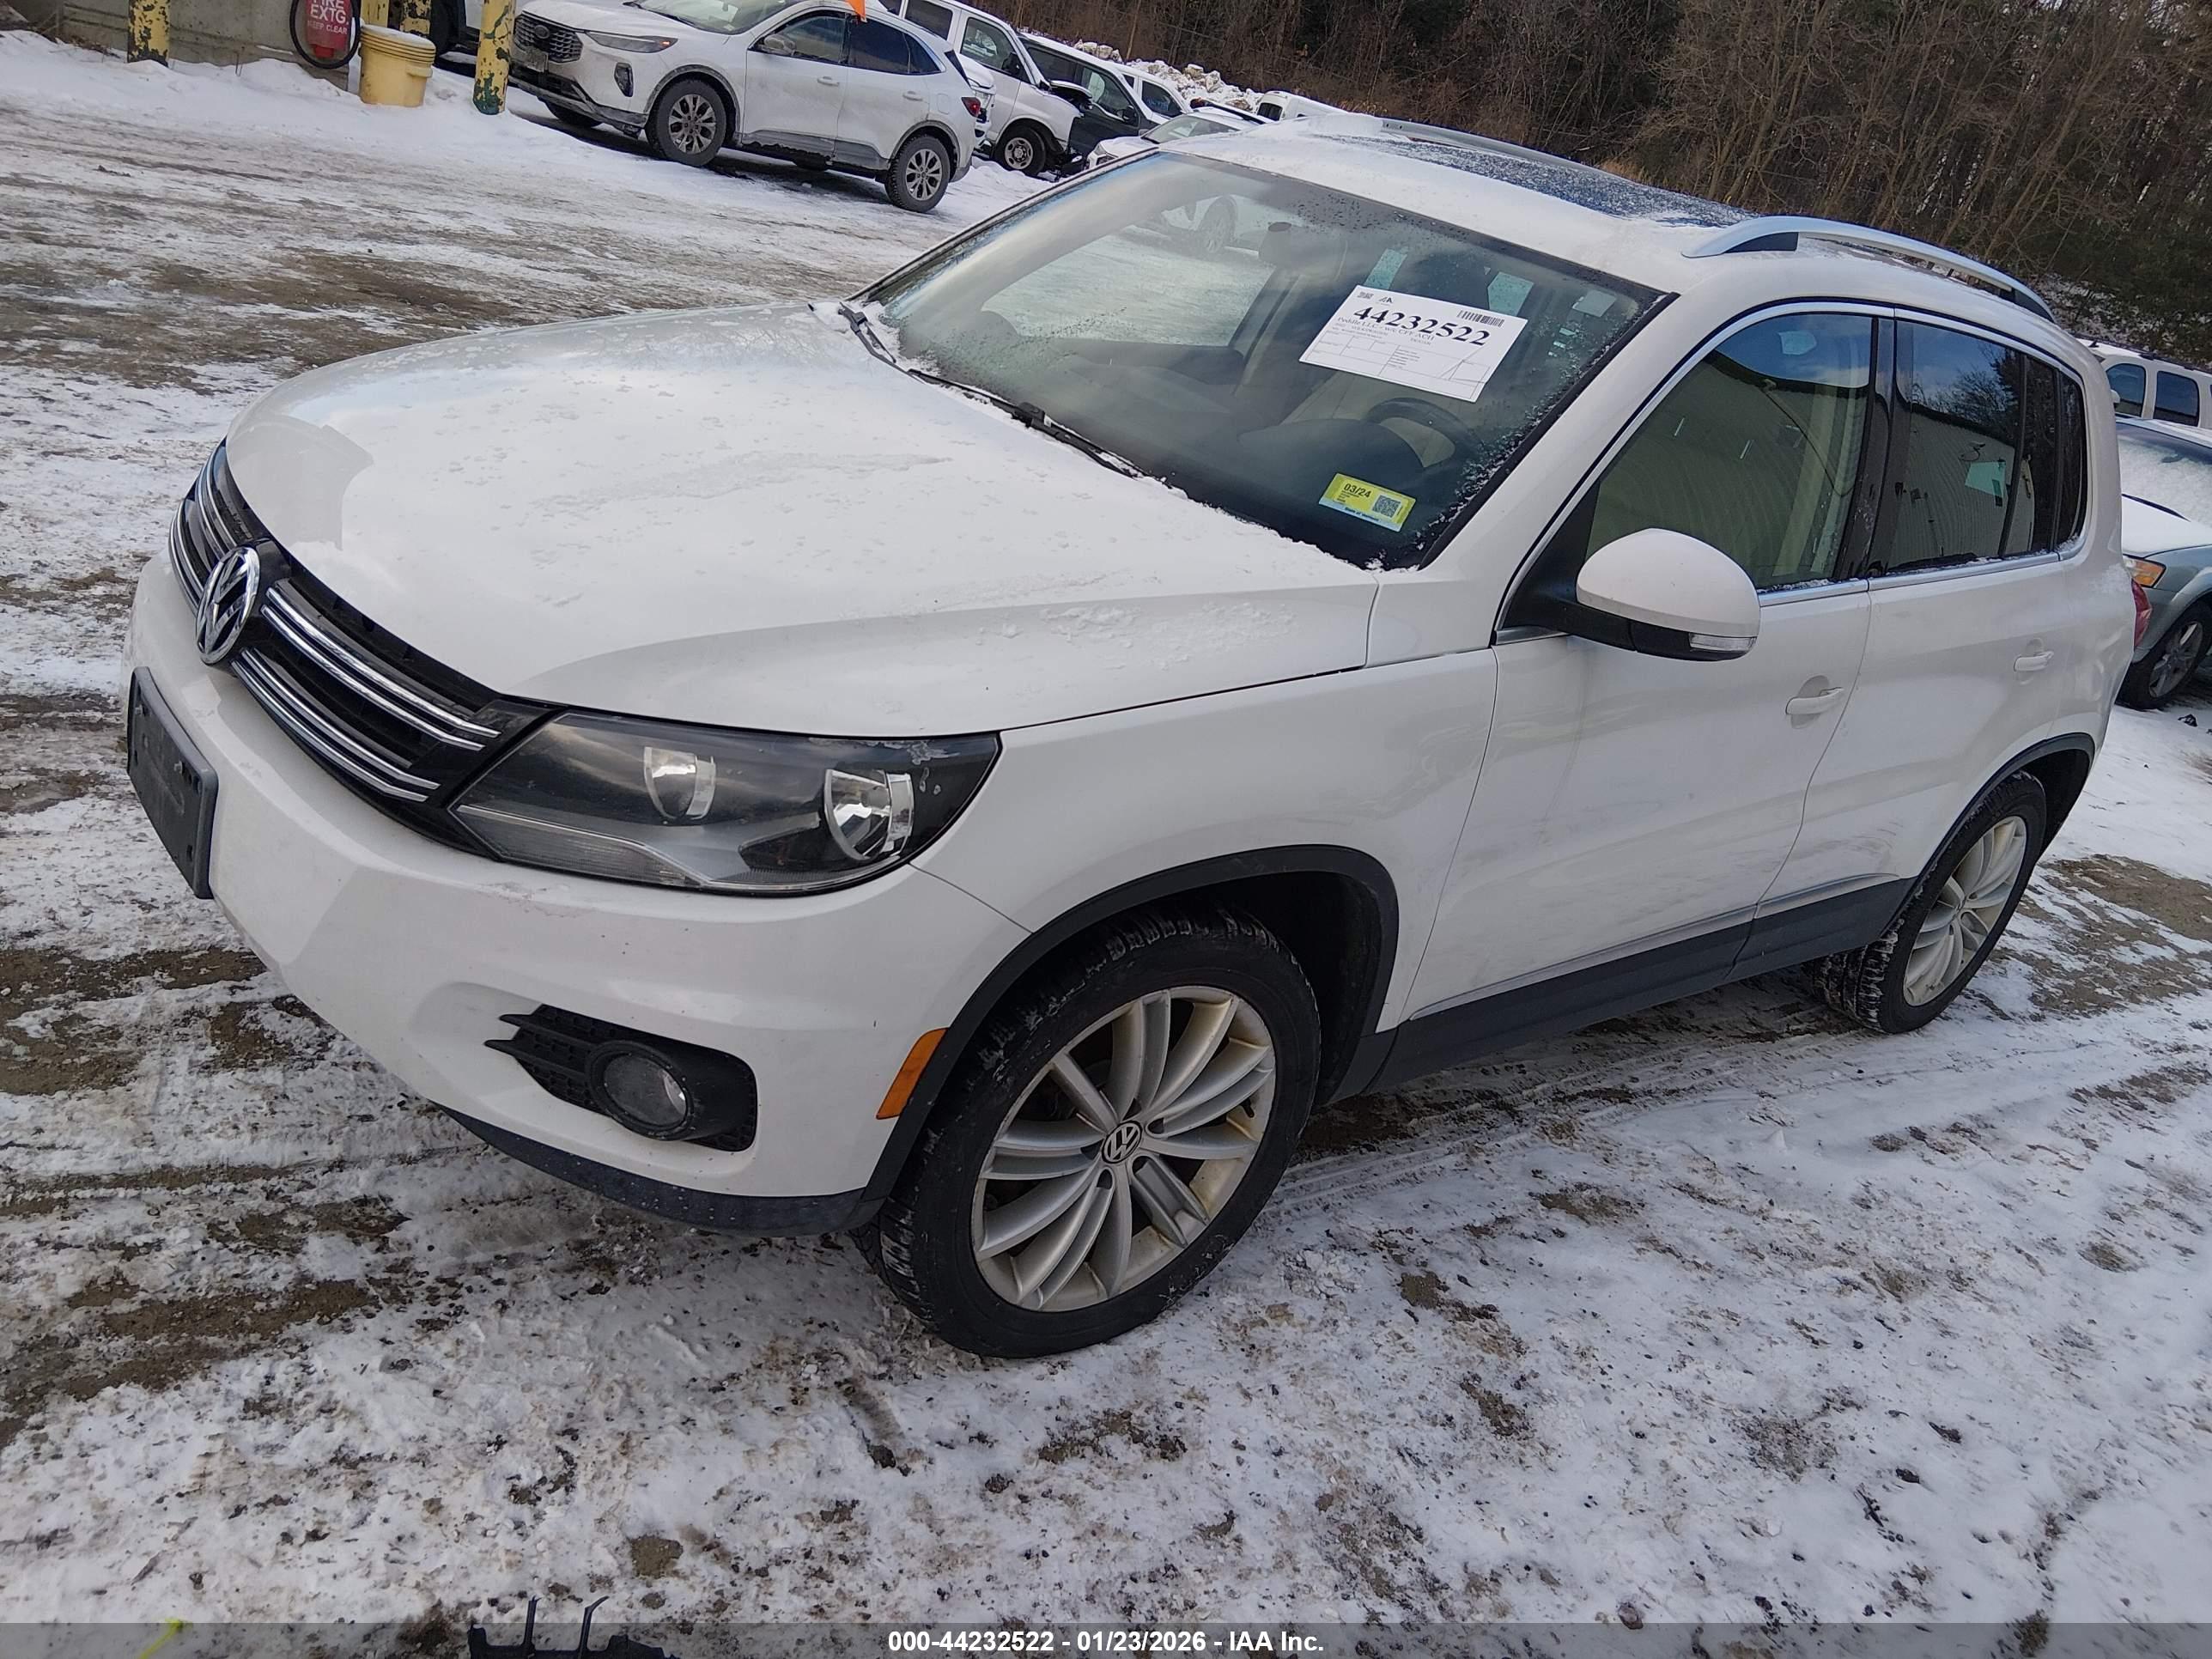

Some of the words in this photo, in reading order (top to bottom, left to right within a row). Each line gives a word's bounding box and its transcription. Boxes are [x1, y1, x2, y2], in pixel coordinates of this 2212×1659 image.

[310, 3, 349, 25] EXTG.
[325, 24, 348, 34] CLEAR
[1353, 307, 1491, 346] 44232522
[1344, 483, 1372, 498] 03/24
